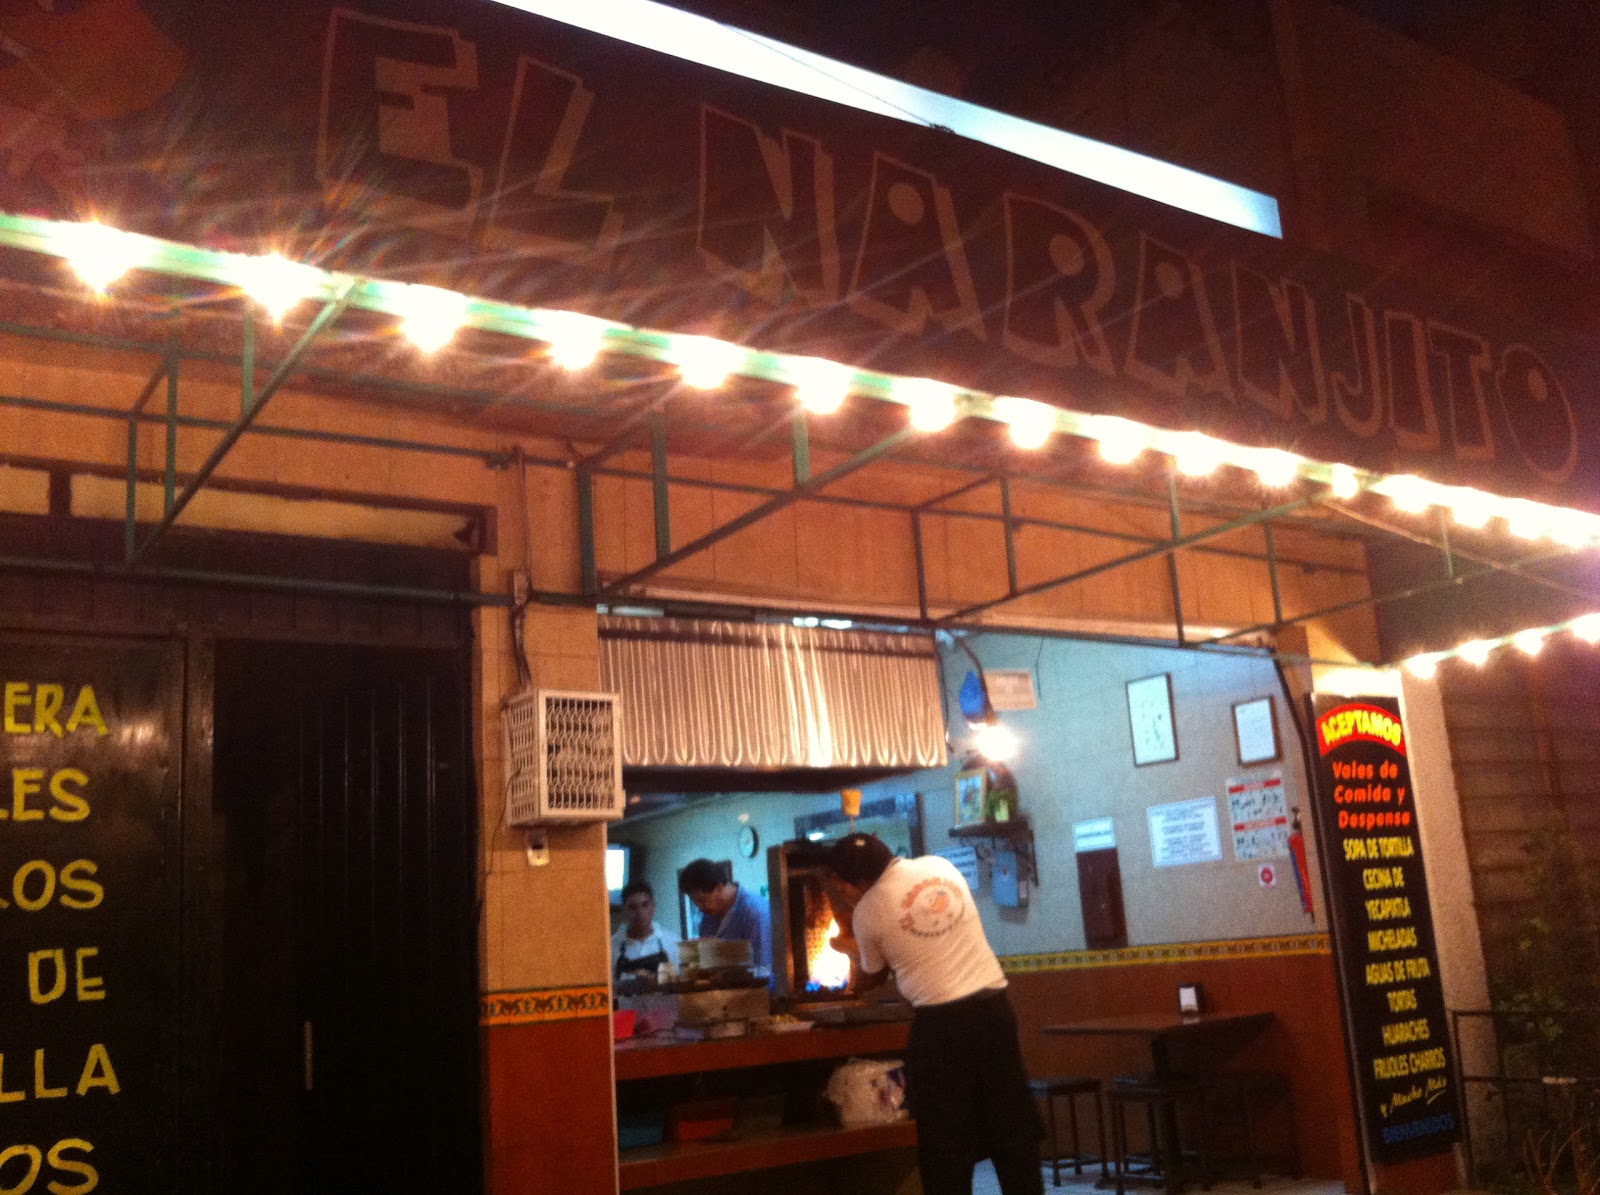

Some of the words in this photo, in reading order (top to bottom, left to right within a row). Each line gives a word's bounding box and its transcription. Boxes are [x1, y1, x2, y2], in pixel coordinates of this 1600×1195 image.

[318, 7, 624, 258] EL
[696, 104, 1579, 484] NARANJITO
[4, 682, 109, 739] ERA
[1321, 709, 1402, 746] ACEPTAMOS
[0, 768, 91, 822] ES
[1334, 783, 1392, 804] Comida
[1379, 759, 1398, 779] de
[28, 947, 106, 1005] DE
